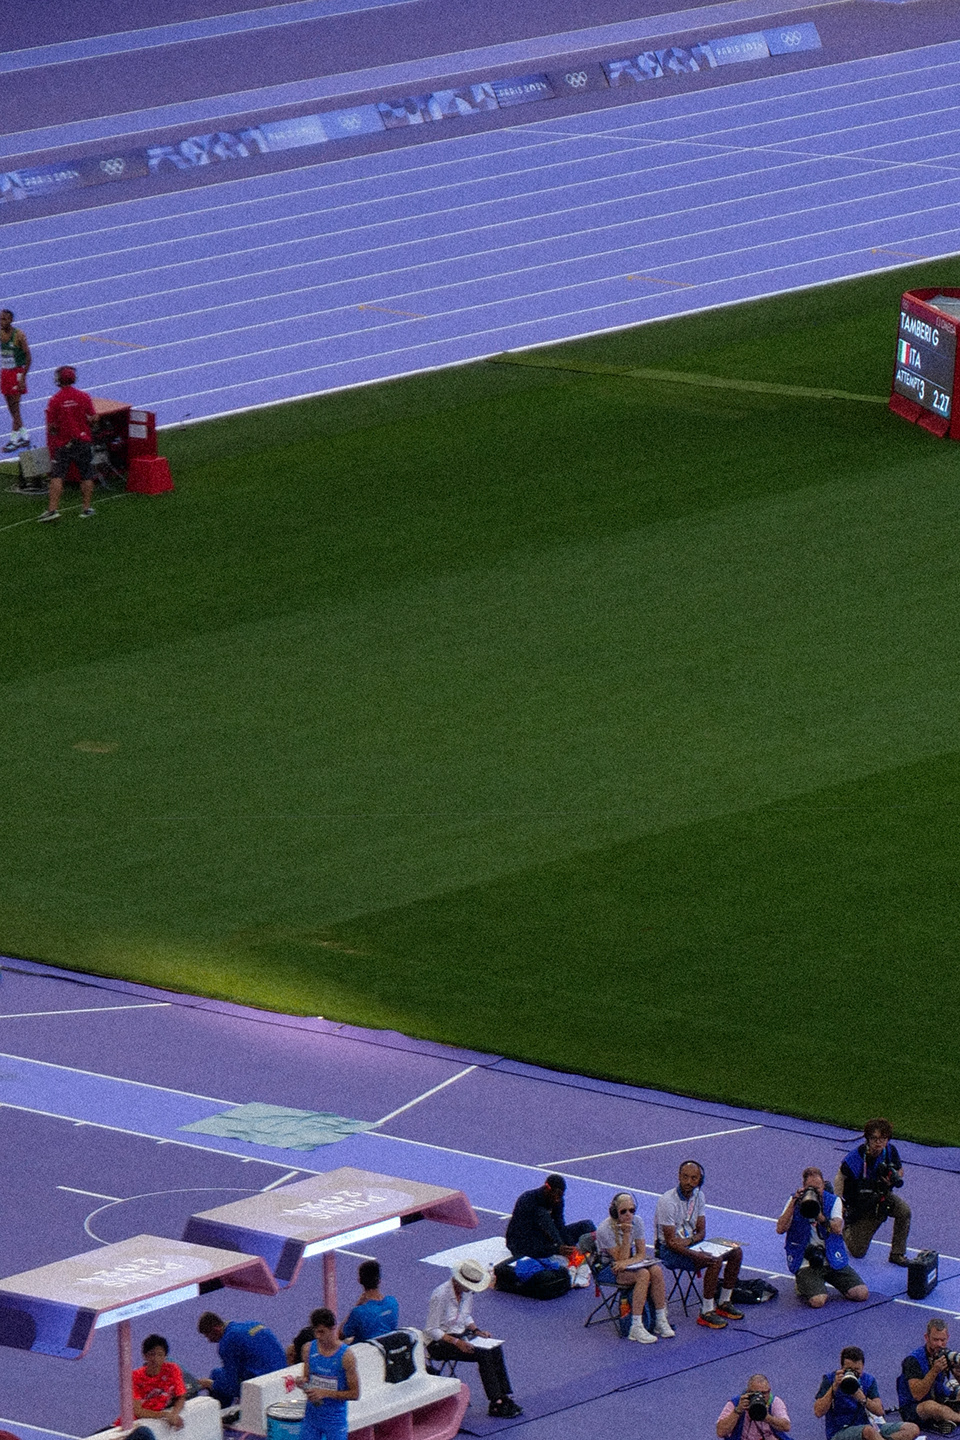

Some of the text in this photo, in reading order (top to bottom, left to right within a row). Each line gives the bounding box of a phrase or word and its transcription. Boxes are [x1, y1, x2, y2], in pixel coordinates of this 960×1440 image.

[900, 312, 940, 347] TAMBERI G
[910, 348, 921, 369] ITA
[896, 369, 951, 412] ATTEMPT 3 2.27
